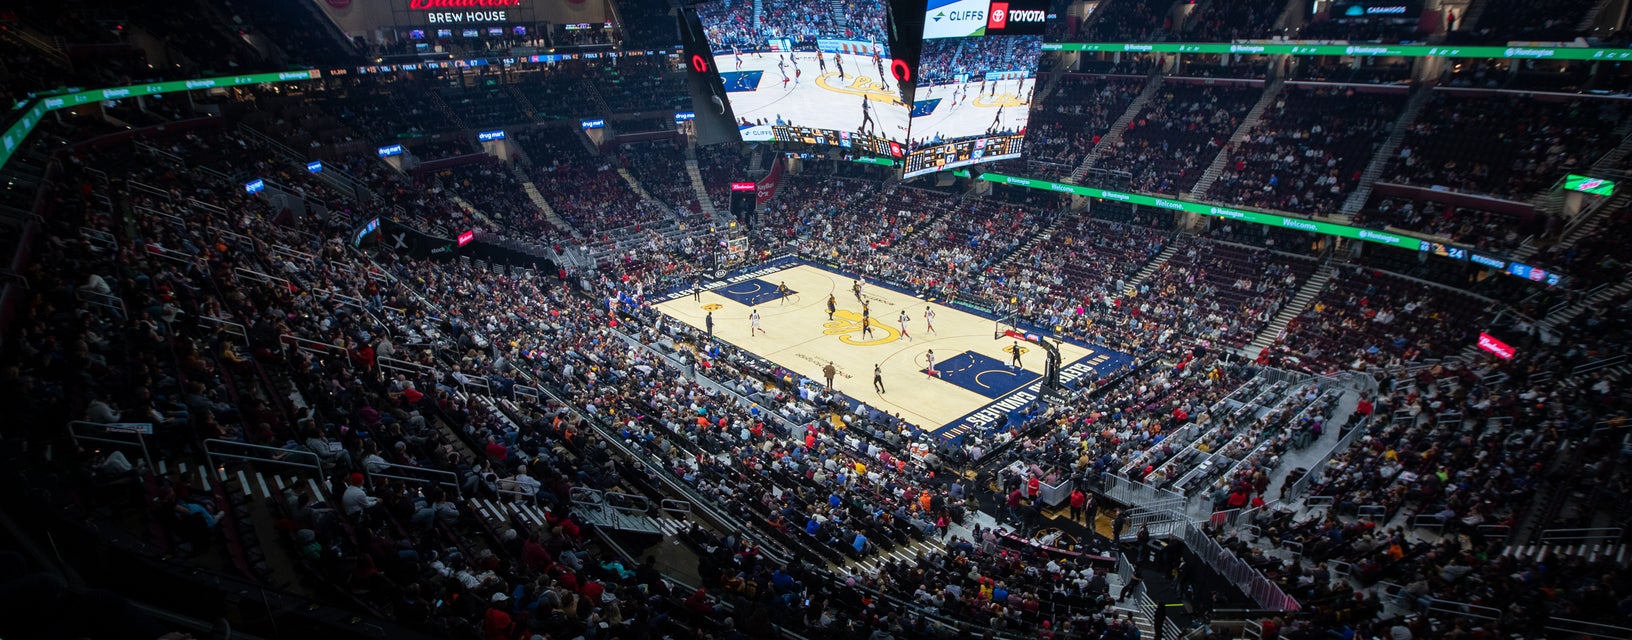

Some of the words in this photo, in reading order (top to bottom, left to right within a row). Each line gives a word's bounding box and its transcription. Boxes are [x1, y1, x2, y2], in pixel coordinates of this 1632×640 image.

[428, 12, 462, 24] BREW
[466, 11, 507, 22] HOUSE
[949, 10, 984, 21] CLIFFS
[1009, 10, 1046, 22] TOYOTA
[946, 154, 954, 163] 67
[1051, 184, 1075, 193] Welcome.
[1155, 199, 1184, 210] Welcome.
[1216, 208, 1244, 218] Huntington
[1283, 218, 1318, 232] Welcome.
[1367, 231, 1400, 244] Huntington
[1449, 248, 1464, 259] 24
[667, 280, 728, 299] CLEVLAND
[966, 390, 1037, 426] CAVALIERS
